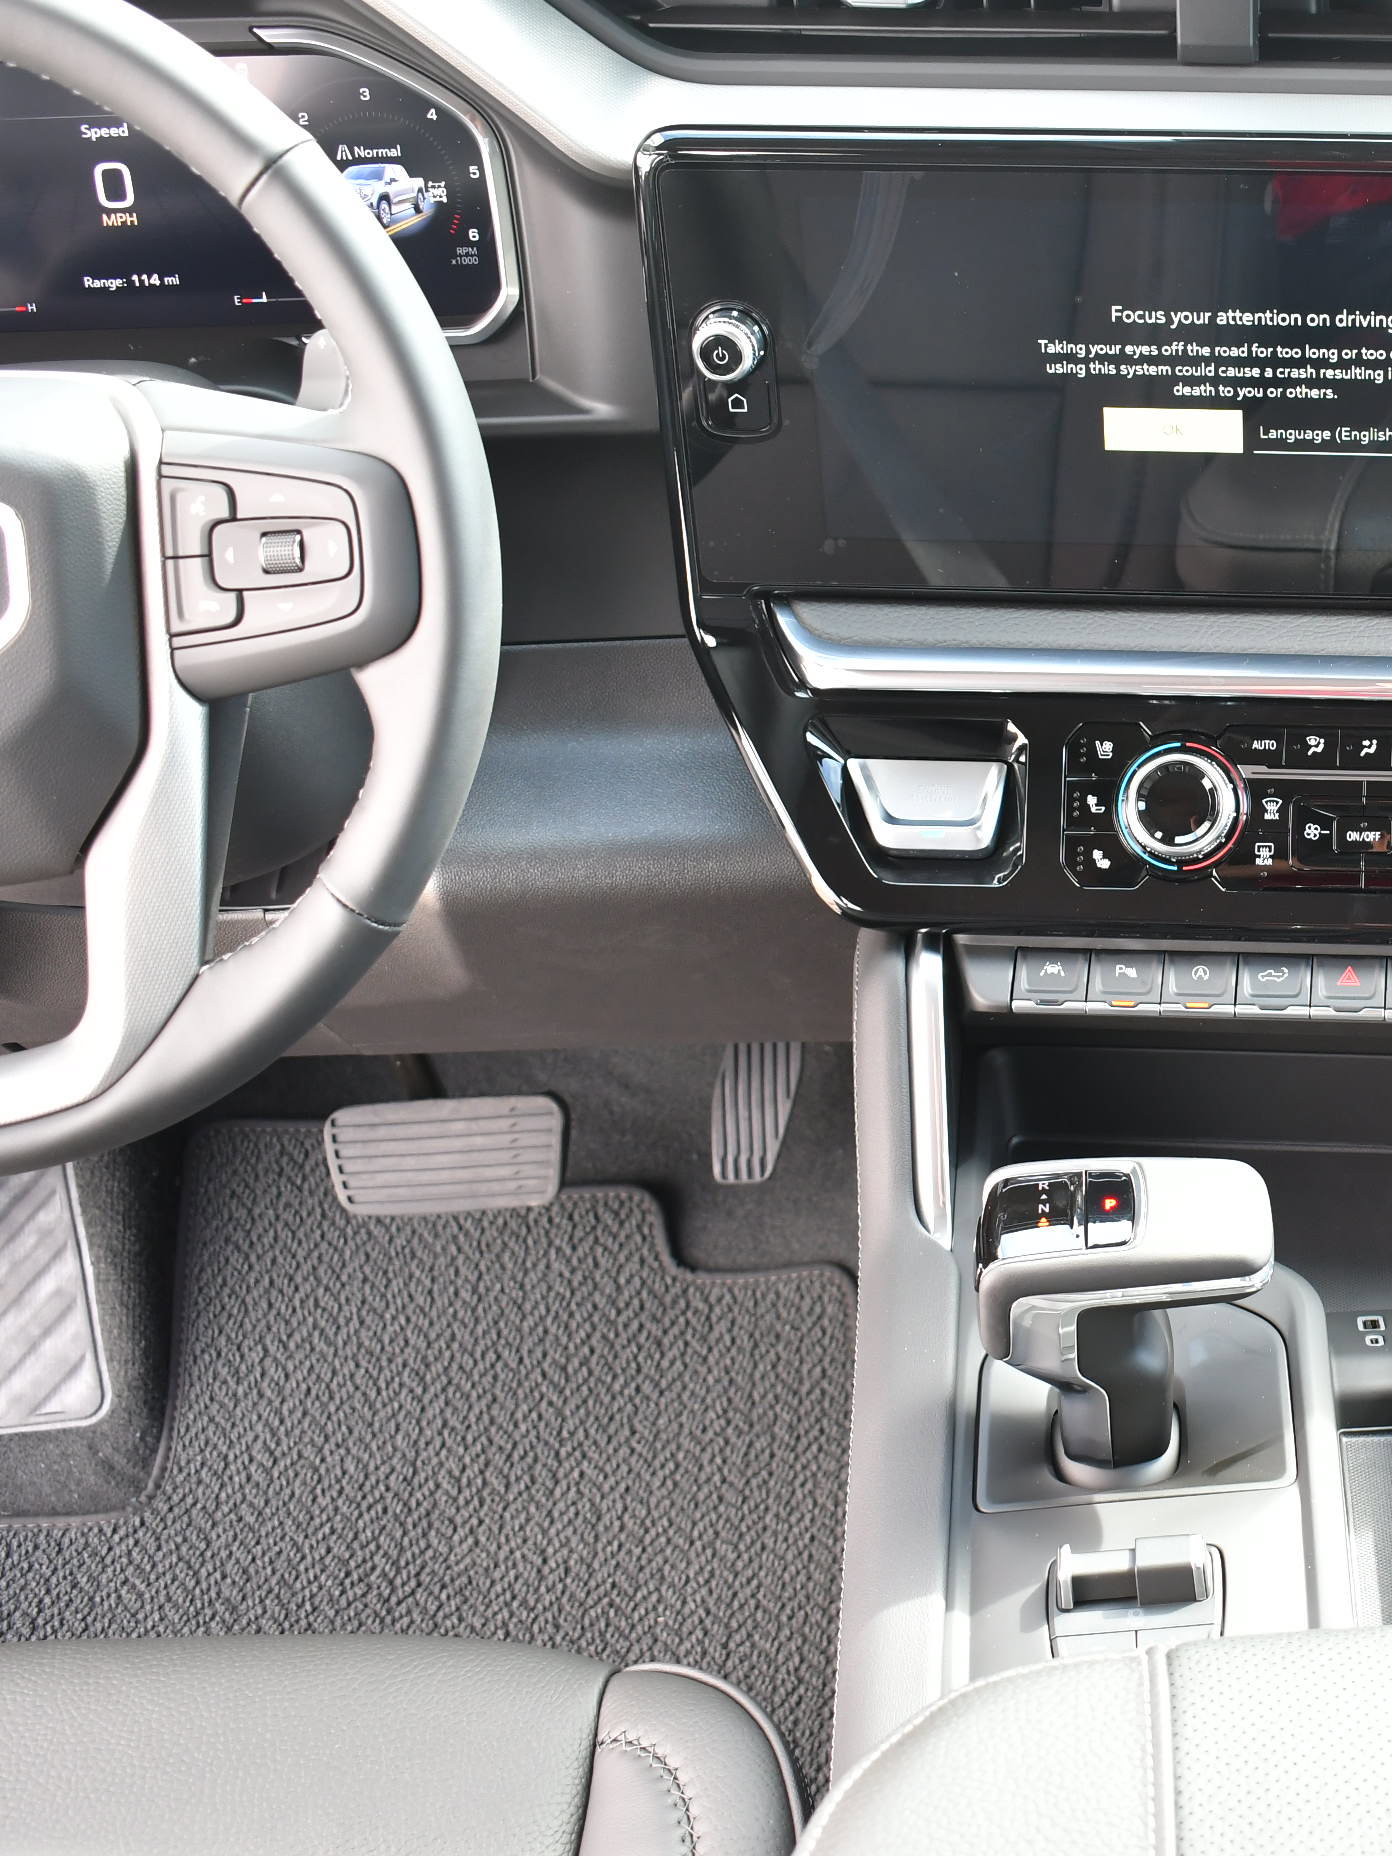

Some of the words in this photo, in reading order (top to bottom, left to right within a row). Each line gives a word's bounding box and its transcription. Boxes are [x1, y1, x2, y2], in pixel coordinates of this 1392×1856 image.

[360, 88, 370, 101] 3
[298, 112, 309, 125] 2
[427, 108, 437, 120] 4
[80, 123, 129, 141] Speed
[354, 144, 402, 158] Normal
[469, 166, 480, 178] 5
[93, 161, 135, 209] 0
[102, 213, 138, 227] MPH
[469, 228, 479, 241] 6
[456, 247, 477, 256] RPM
[451, 256, 479, 265] x1000
[83, 276, 128, 290] Range:
[131, 273, 161, 287] 114
[164, 274, 180, 286] mi
[234, 295, 242, 306] E
[27, 303, 37, 313] H
[1111, 305, 1166, 324] Focus
[1170, 311, 1211, 329] your
[1216, 309, 1302, 326] attention
[1306, 312, 1330, 327] on
[1037, 339, 1086, 358] Taking
[1089, 344, 1120, 358] your
[1124, 345, 1159, 358] eyes
[1161, 341, 1185, 356] off
[1186, 342, 1211, 356] the
[1215, 343, 1248, 357] road
[1251, 343, 1273, 358] for
[1276, 345, 1302, 359] too
[1305, 344, 1338, 363] long
[1341, 349, 1359, 360] or
[1361, 346, 1387, 360] too
[1046, 361, 1086, 378] using
[1089, 360, 1117, 375] this
[1119, 363, 1172, 378] system
[1175, 362, 1215, 376] could
[1218, 365, 1260, 379] cause
[1264, 367, 1273, 378] a
[1276, 364, 1316, 379] crash
[1319, 365, 1384, 384] resulting
[1173, 382, 1215, 396] death
[1218, 384, 1234, 397] to
[1236, 386, 1263, 401] you
[1267, 387, 1283, 398] or
[1286, 384, 1338, 399] others.
[1259, 425, 1332, 443] Language
[1252, 740, 1277, 750] AUTO
[1264, 812, 1280, 820] MAX
[1346, 831, 1381, 842] ON/OFF
[1255, 858, 1273, 866] REAR
[1038, 1182, 1050, 1191] R
[1038, 1203, 1050, 1214] N
[1104, 1196, 1118, 1211] P
